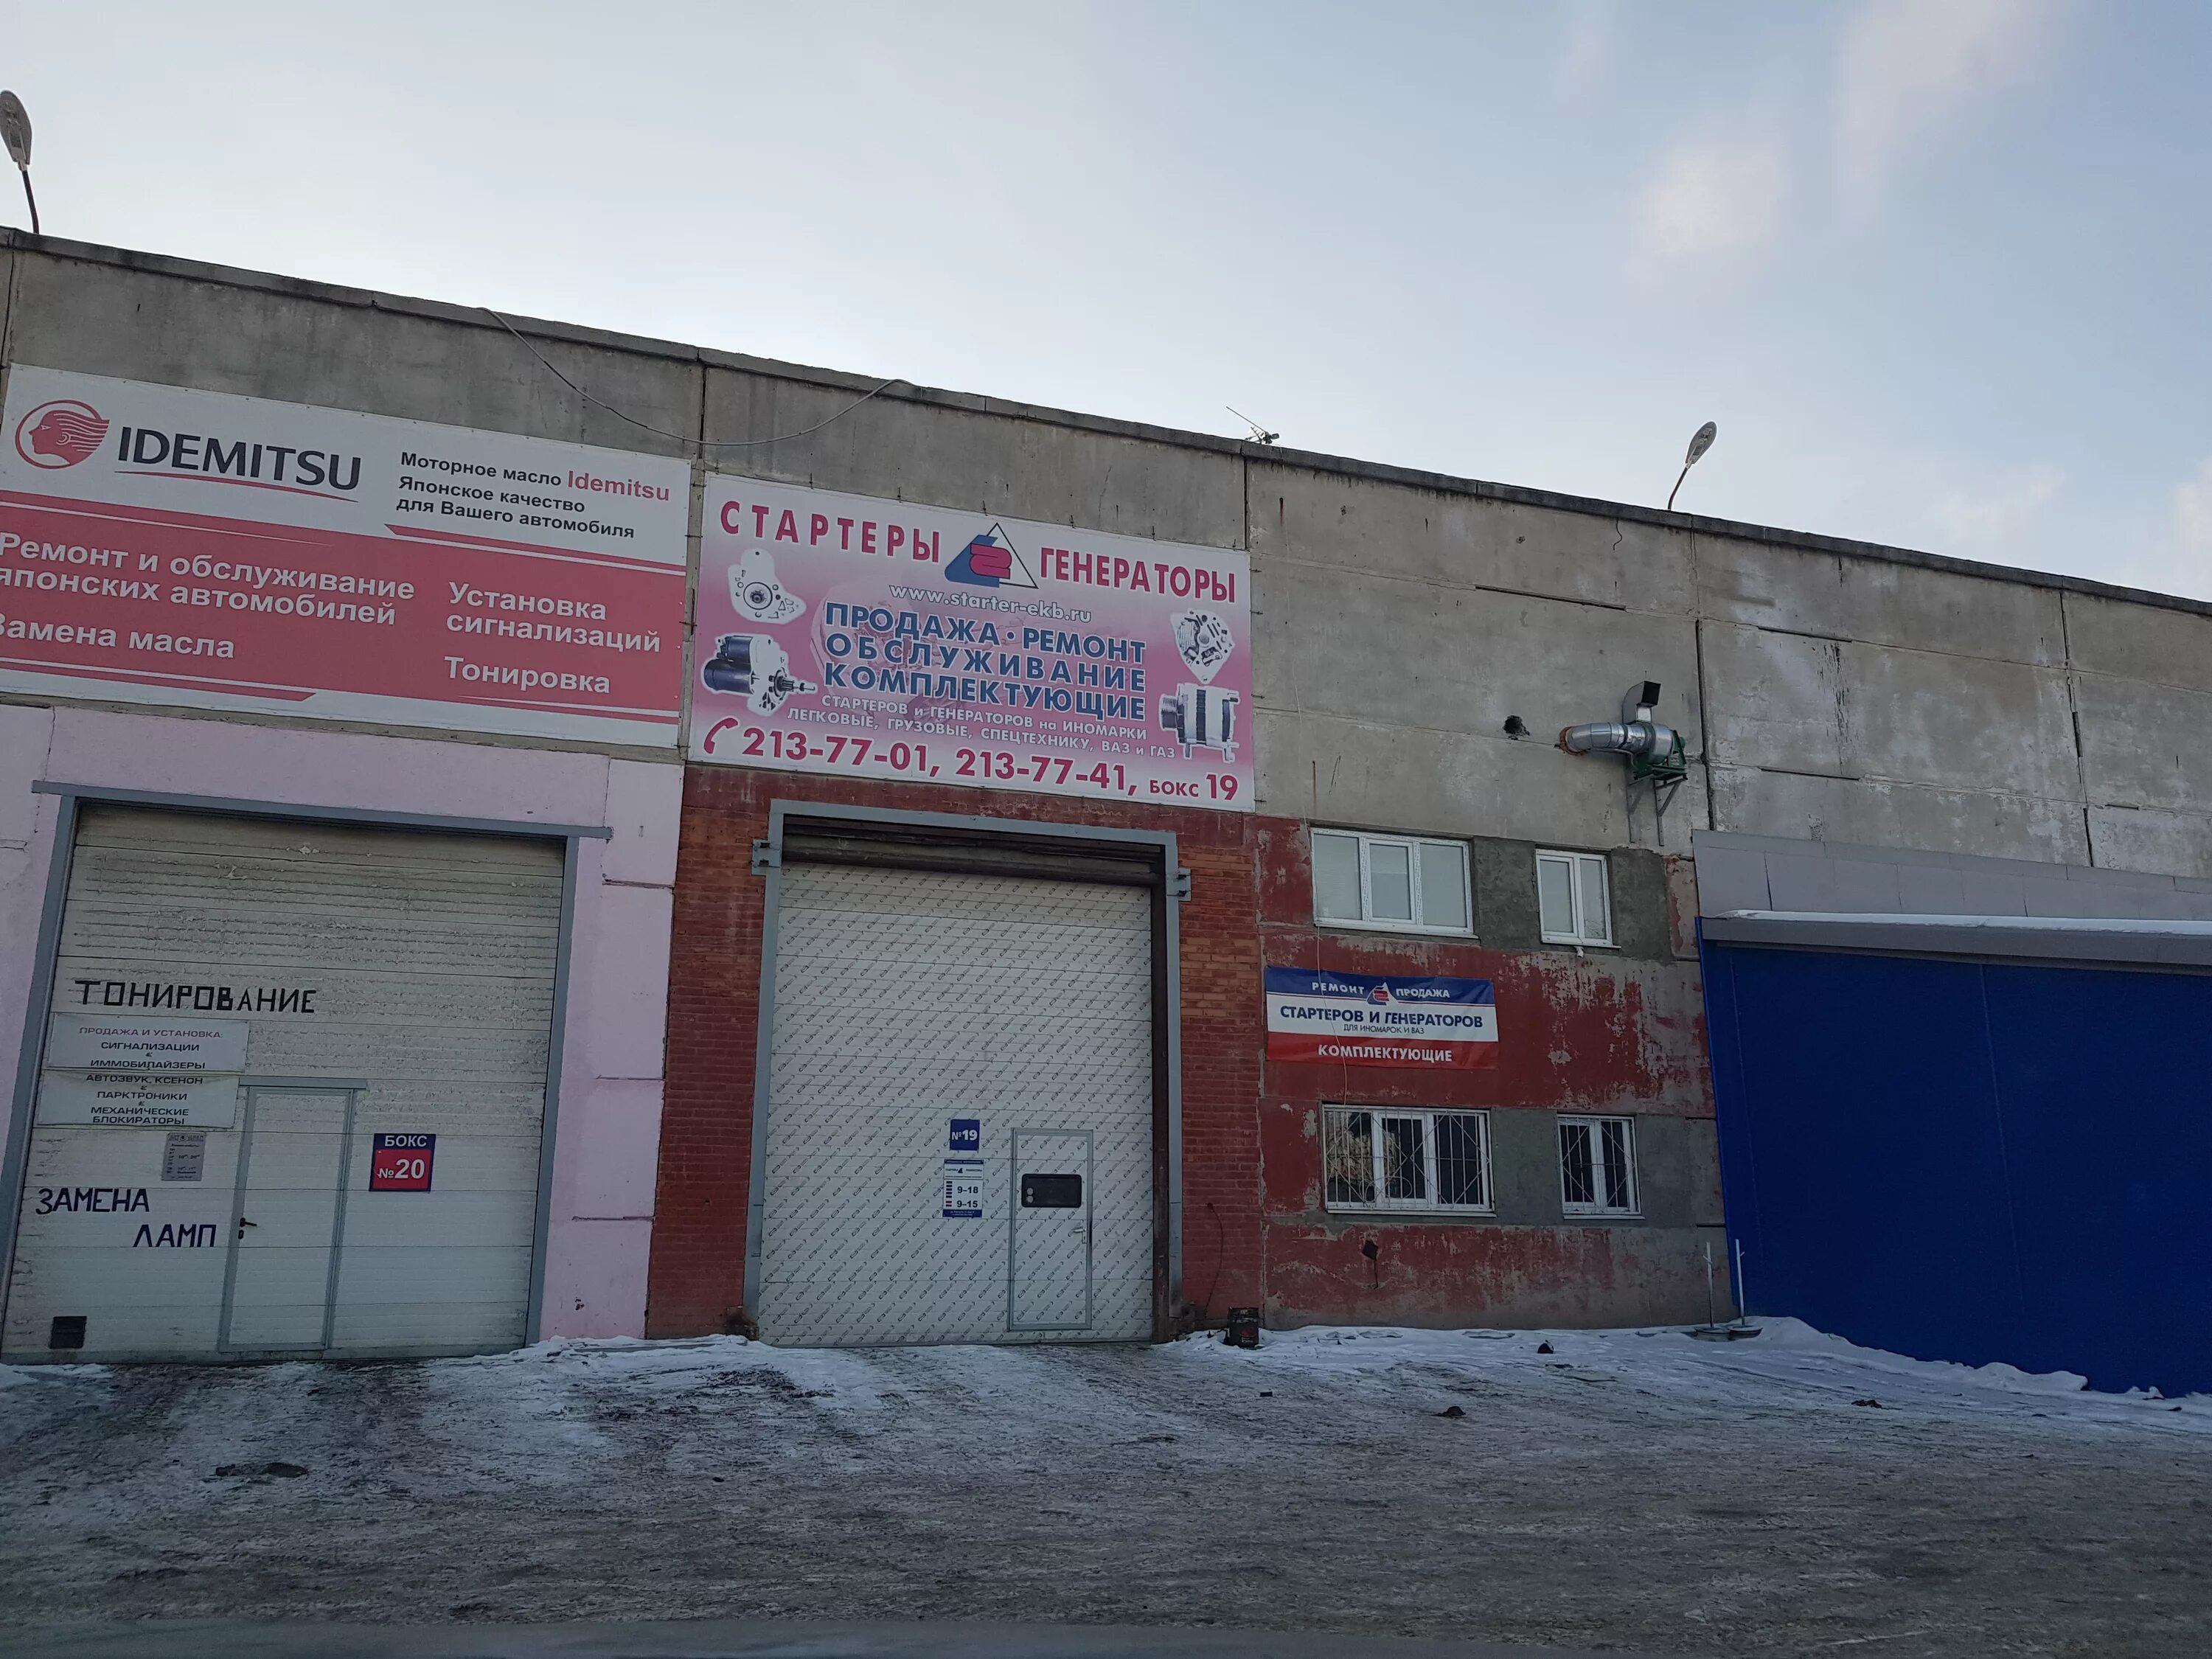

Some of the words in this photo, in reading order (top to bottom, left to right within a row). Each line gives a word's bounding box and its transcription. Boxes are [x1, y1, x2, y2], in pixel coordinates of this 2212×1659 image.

[118, 425, 361, 490] IDEMITSU
[401, 451, 498, 478] Моторное
[503, 469, 562, 487] масло
[568, 470, 670, 501] Idemitsu
[398, 476, 494, 501] Японское
[500, 493, 585, 512] качество
[396, 498, 434, 513] для
[441, 501, 514, 523] Вашего
[519, 513, 635, 538] автомобиля
[0, 532, 128, 568] Ремонт
[139, 553, 159, 572] и
[170, 554, 414, 599] обслуживание
[720, 500, 940, 563] СТАРТЕРЫ
[1040, 547, 1235, 603] ГЕНЕРАТОРЫ
[170, 585, 396, 625] автомобилей
[448, 581, 607, 621] Установка
[889, 585, 1091, 623] www.starter-ekb.ru
[0, 613, 116, 647] амена
[129, 630, 234, 658] масла
[446, 614, 661, 653] сигнализаций
[826, 602, 1001, 646] ПРОДАЖА
[1023, 626, 1146, 664] РЕМОНТ
[444, 655, 611, 694] Тонировка
[826, 633, 1145, 692] ОБСЛУЖИВАНИЕ
[824, 662, 1145, 721] КОМПЛЕКТУЮЩИЕ
[787, 708, 879, 730] ЛЕГКОВЫЕ,
[888, 718, 973, 739] ГРУЗОВЫЕ,
[981, 727, 1095, 752] СПЕЦТЕХНИКУ,
[1102, 740, 1130, 754] ВАЗ
[1150, 745, 1175, 758] ГАЗ
[821, 695, 908, 714] СТАРТЕРОВ
[914, 707, 923, 716] и
[931, 706, 1033, 728] ГЕНЕРАТОРОВ
[1039, 721, 1057, 731] на
[1062, 720, 1147, 740] ИНОМАРКИ
[742, 727, 940, 778] 213-77-01,
[955, 748, 1137, 796] 213-77-41,
[1149, 779, 1199, 797] БОКС
[1206, 773, 1238, 801] 19
[74, 980, 317, 1013] ТОНИРОВАНИЕ
[1312, 981, 1364, 995] РЕМОНТ
[1396, 987, 1450, 998] ПРОДАЖА
[79, 1027, 139, 1036] ПРОДАЖА
[1280, 1005, 1363, 1023] СТАРТЕРОВ
[1369, 1011, 1380, 1023] И
[1385, 1011, 1483, 1028] ГЕНЕРАТОРОВ
[1343, 1023, 1358, 1032] ДЛЯ
[1360, 1024, 1402, 1034] ИНОМАРОК
[90, 1060, 206, 1069] ИММОБИЛАЙЗЕРЫ
[101, 1042, 200, 1052] СИГНАЛИЗАЦИИ
[1318, 1044, 1453, 1063] КОМПЛЕКТУЮЩИЕ
[97, 1091, 187, 1100] ПАРКТРОНИКИ
[155, 1077, 203, 1085] КСЕНОН
[91, 1107, 189, 1116] МЕХАНИЧЕСКИЕ
[93, 1116, 184, 1125] БЛОКИРАТОРЫ
[384, 1135, 428, 1147] БОКС
[35, 1187, 150, 1215] ЗАМЕНА
[133, 1223, 217, 1248] ЛАМП
